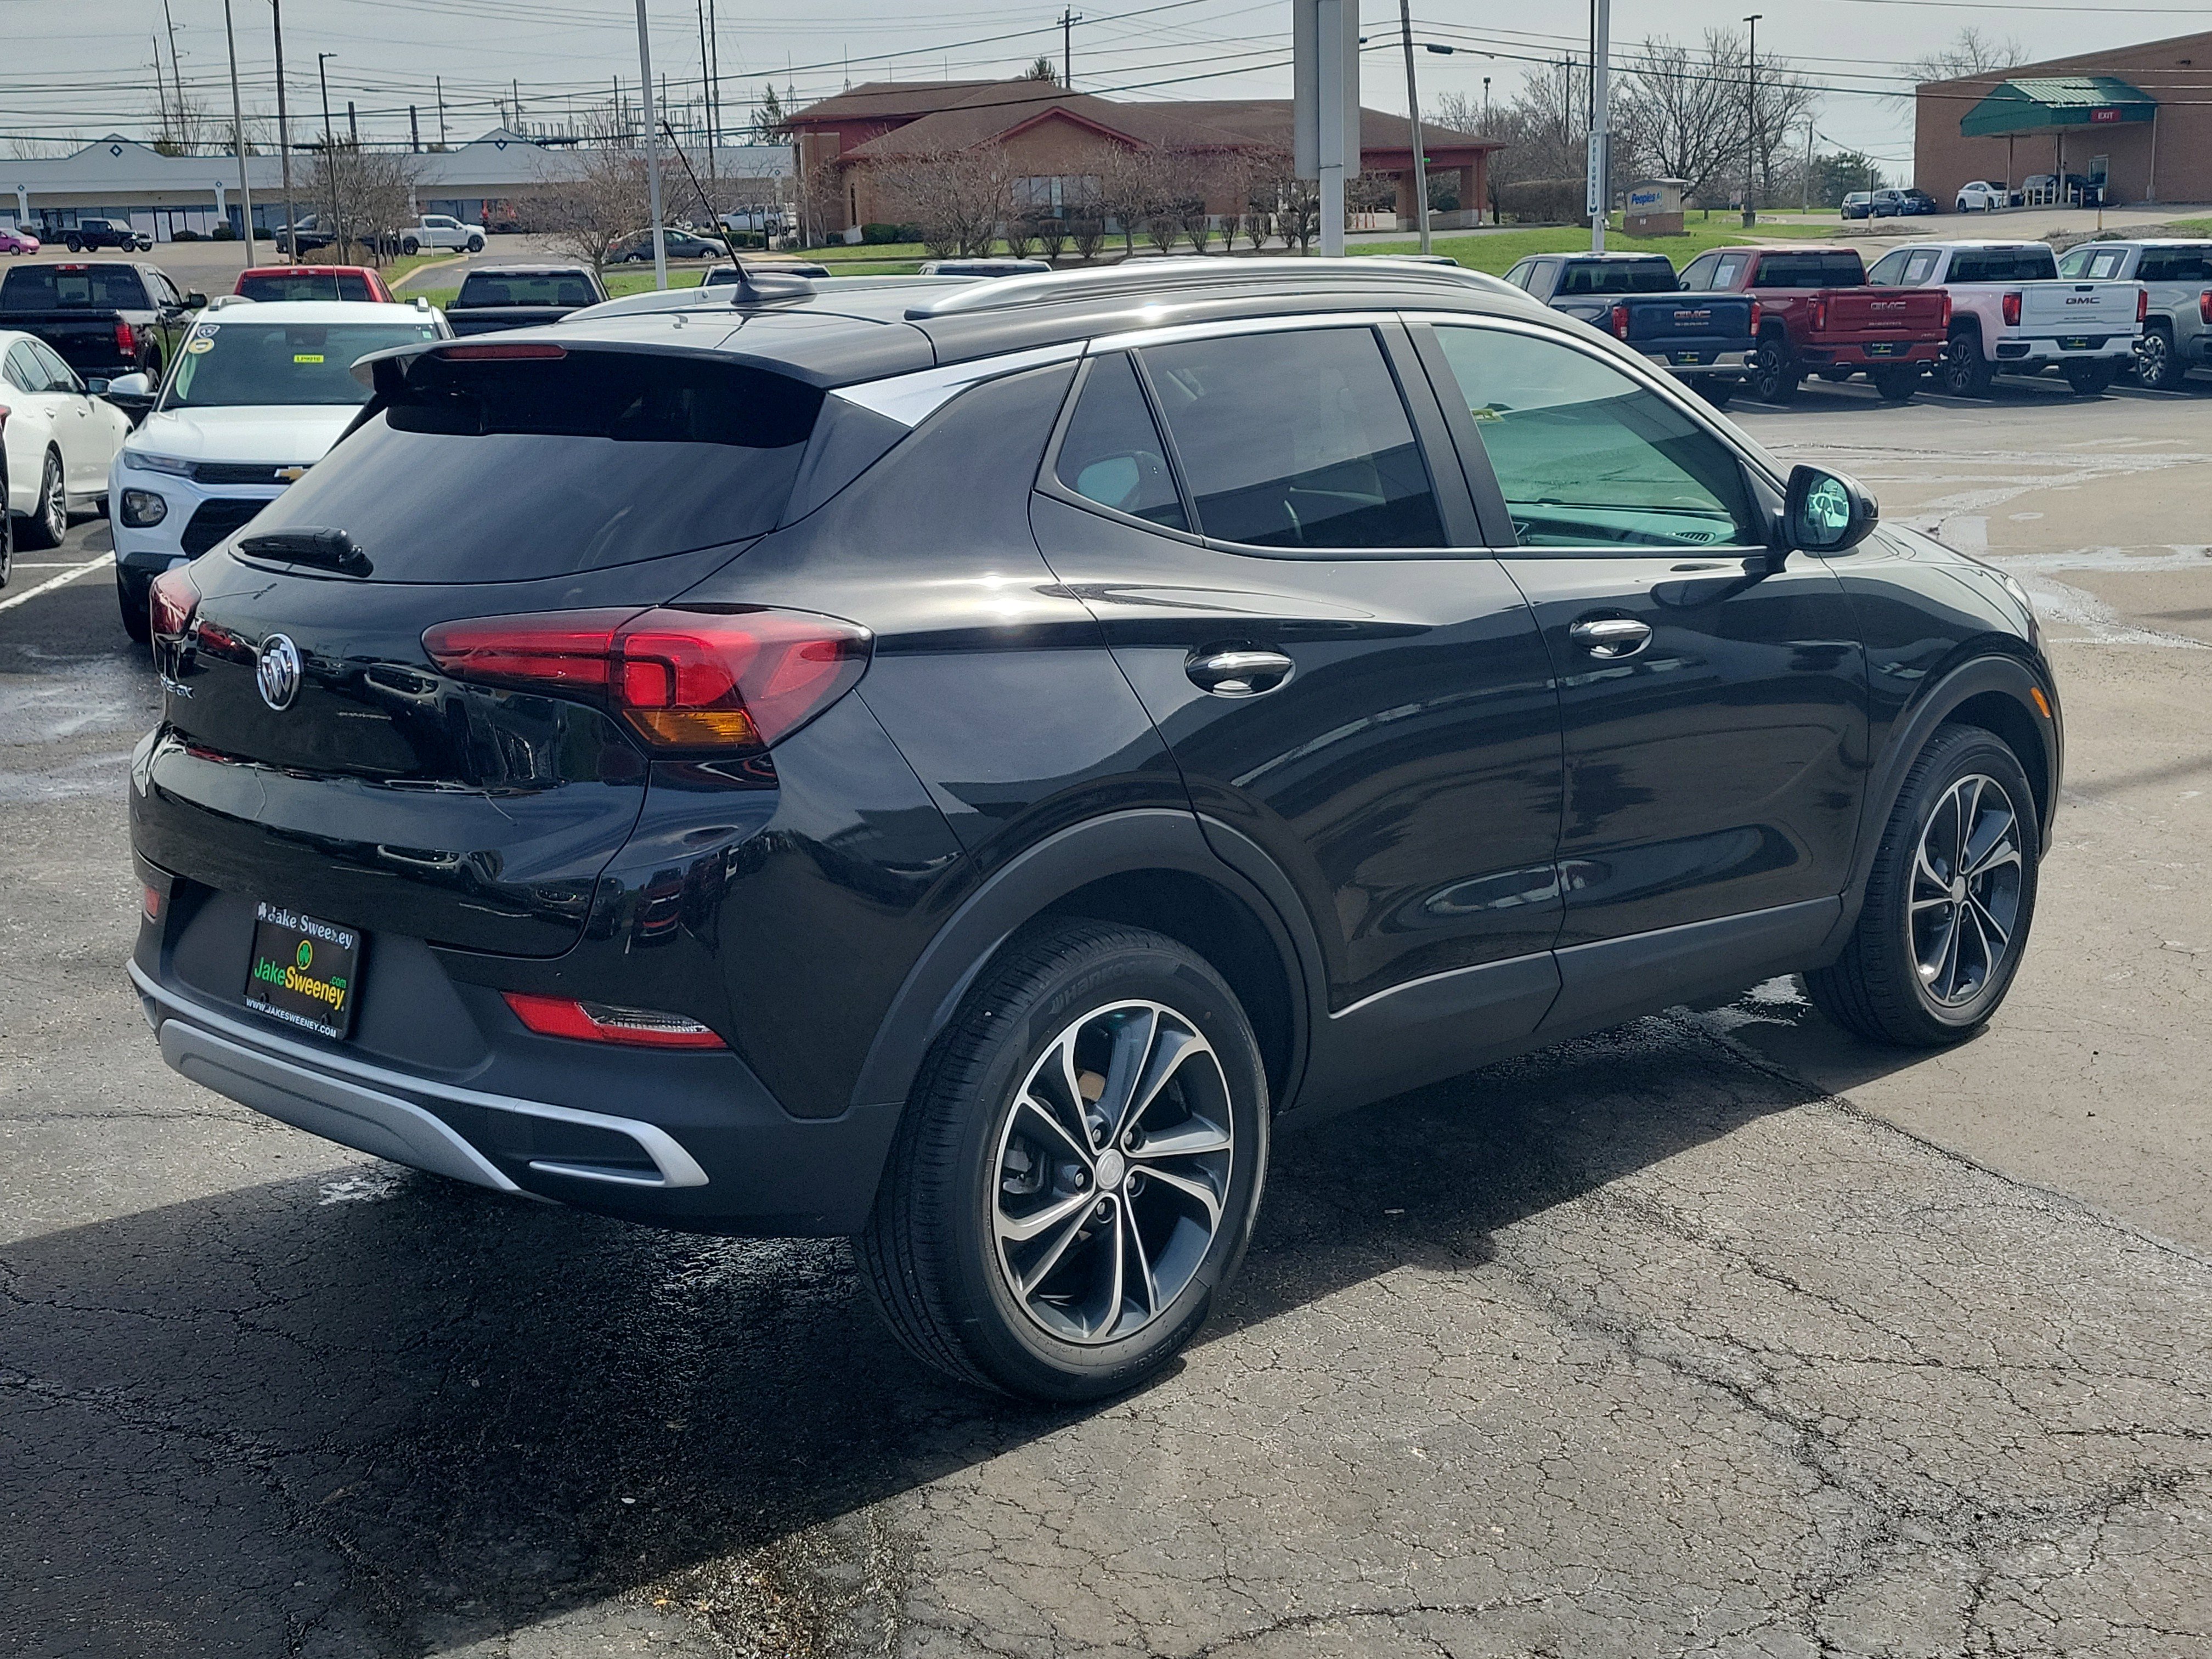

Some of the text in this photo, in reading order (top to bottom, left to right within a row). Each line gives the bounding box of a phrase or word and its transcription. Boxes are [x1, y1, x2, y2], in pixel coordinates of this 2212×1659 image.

[2097, 111, 2114, 120] EXIT
[1632, 190, 1656, 206] Peoples
[1870, 301, 1906, 311] GMC
[1674, 309, 1711, 319] GMC
[267, 906, 353, 950] Jake Sweeney
[246, 997, 337, 1039] WWW.JAKESWEENEY.COM
